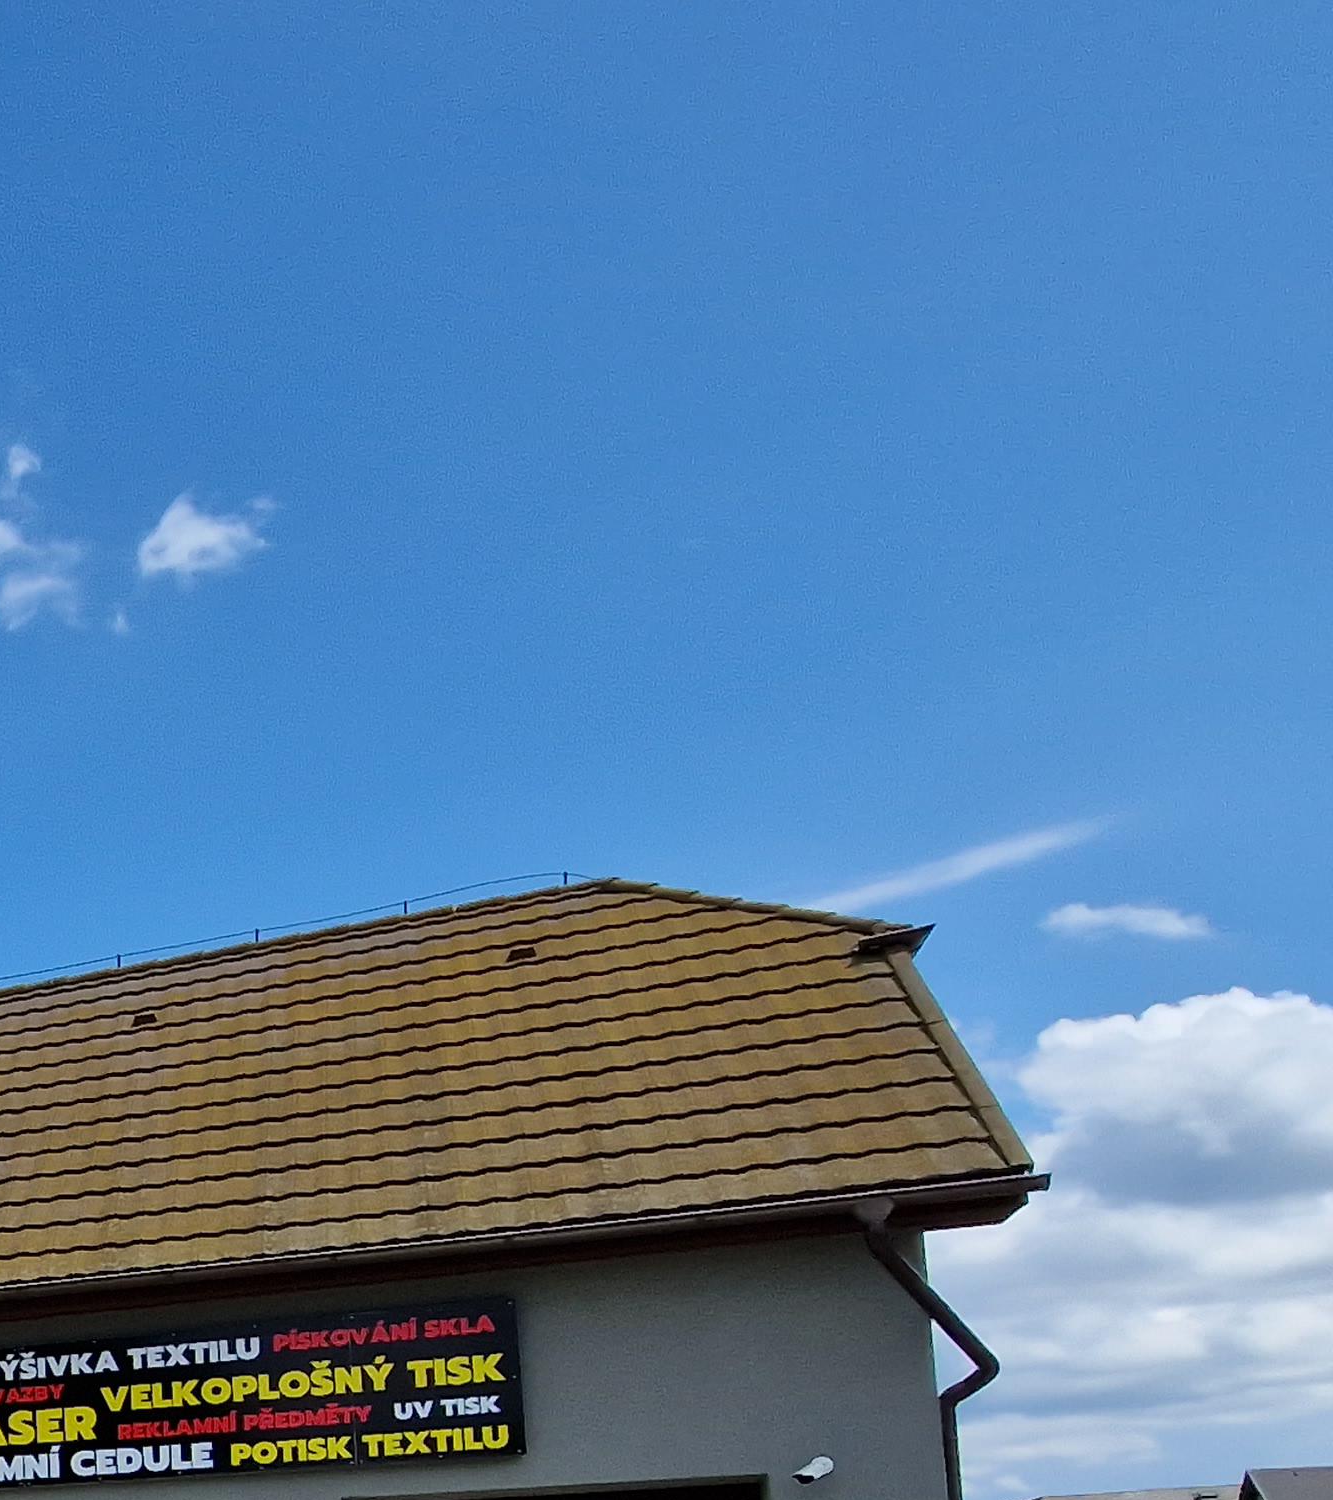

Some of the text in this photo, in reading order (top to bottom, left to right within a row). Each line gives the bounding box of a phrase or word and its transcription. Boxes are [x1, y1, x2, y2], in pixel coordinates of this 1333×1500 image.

[272, 1314, 496, 1352] PÍSKOVÁNÍ SKLA
[127, 1336, 260, 1370] TEXTILU
[100, 1353, 507, 1412] VELKOPLOŠNÝ TISK
[117, 1402, 372, 1440] REKLAMNÍ PŘEDMĚTY
[393, 1395, 501, 1421] UV TISK
[70, 1442, 213, 1477] CEDULE
[230, 1424, 510, 1467] POTISK TEXTILU
